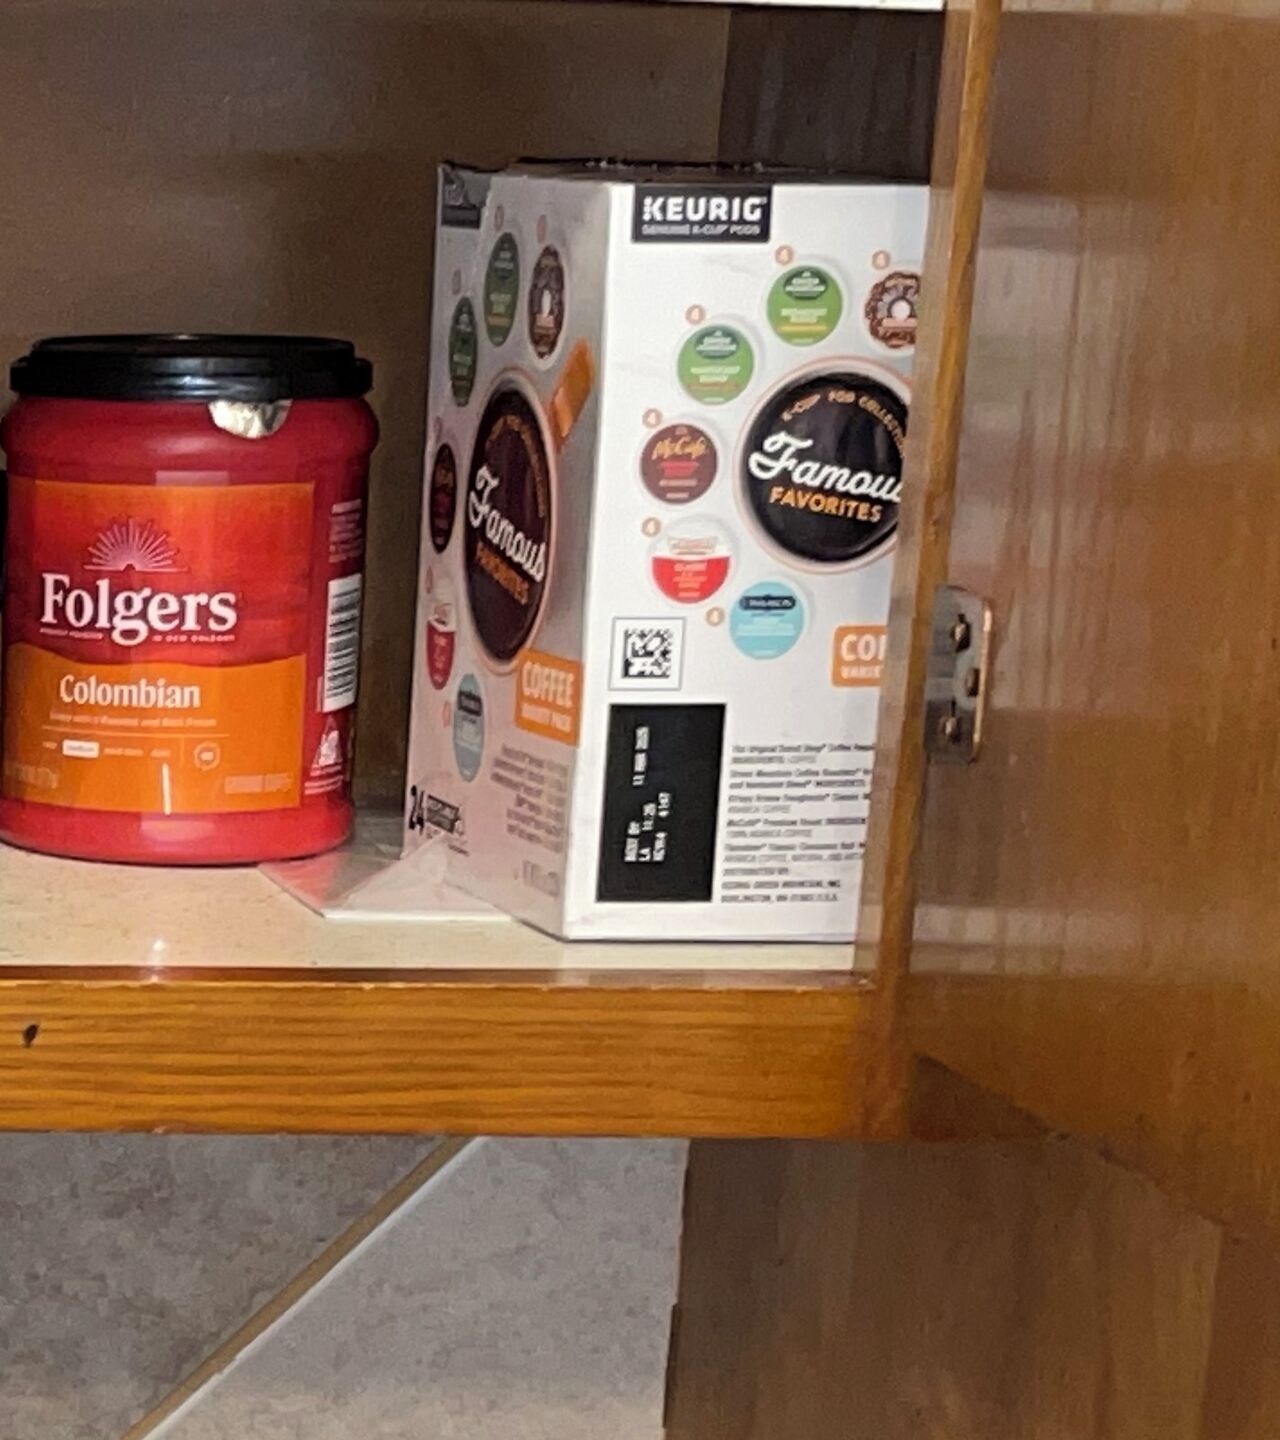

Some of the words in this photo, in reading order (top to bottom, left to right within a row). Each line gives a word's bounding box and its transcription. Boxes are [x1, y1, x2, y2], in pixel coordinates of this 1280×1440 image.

[642, 195, 765, 222] KEURIG
[748, 432, 903, 503] Famou
[468, 465, 547, 582] Famous
[769, 486, 884, 523] FAVORITES
[40, 572, 238, 646] Folgers
[59, 674, 202, 708] Colombian
[522, 660, 576, 707] COFFEE
